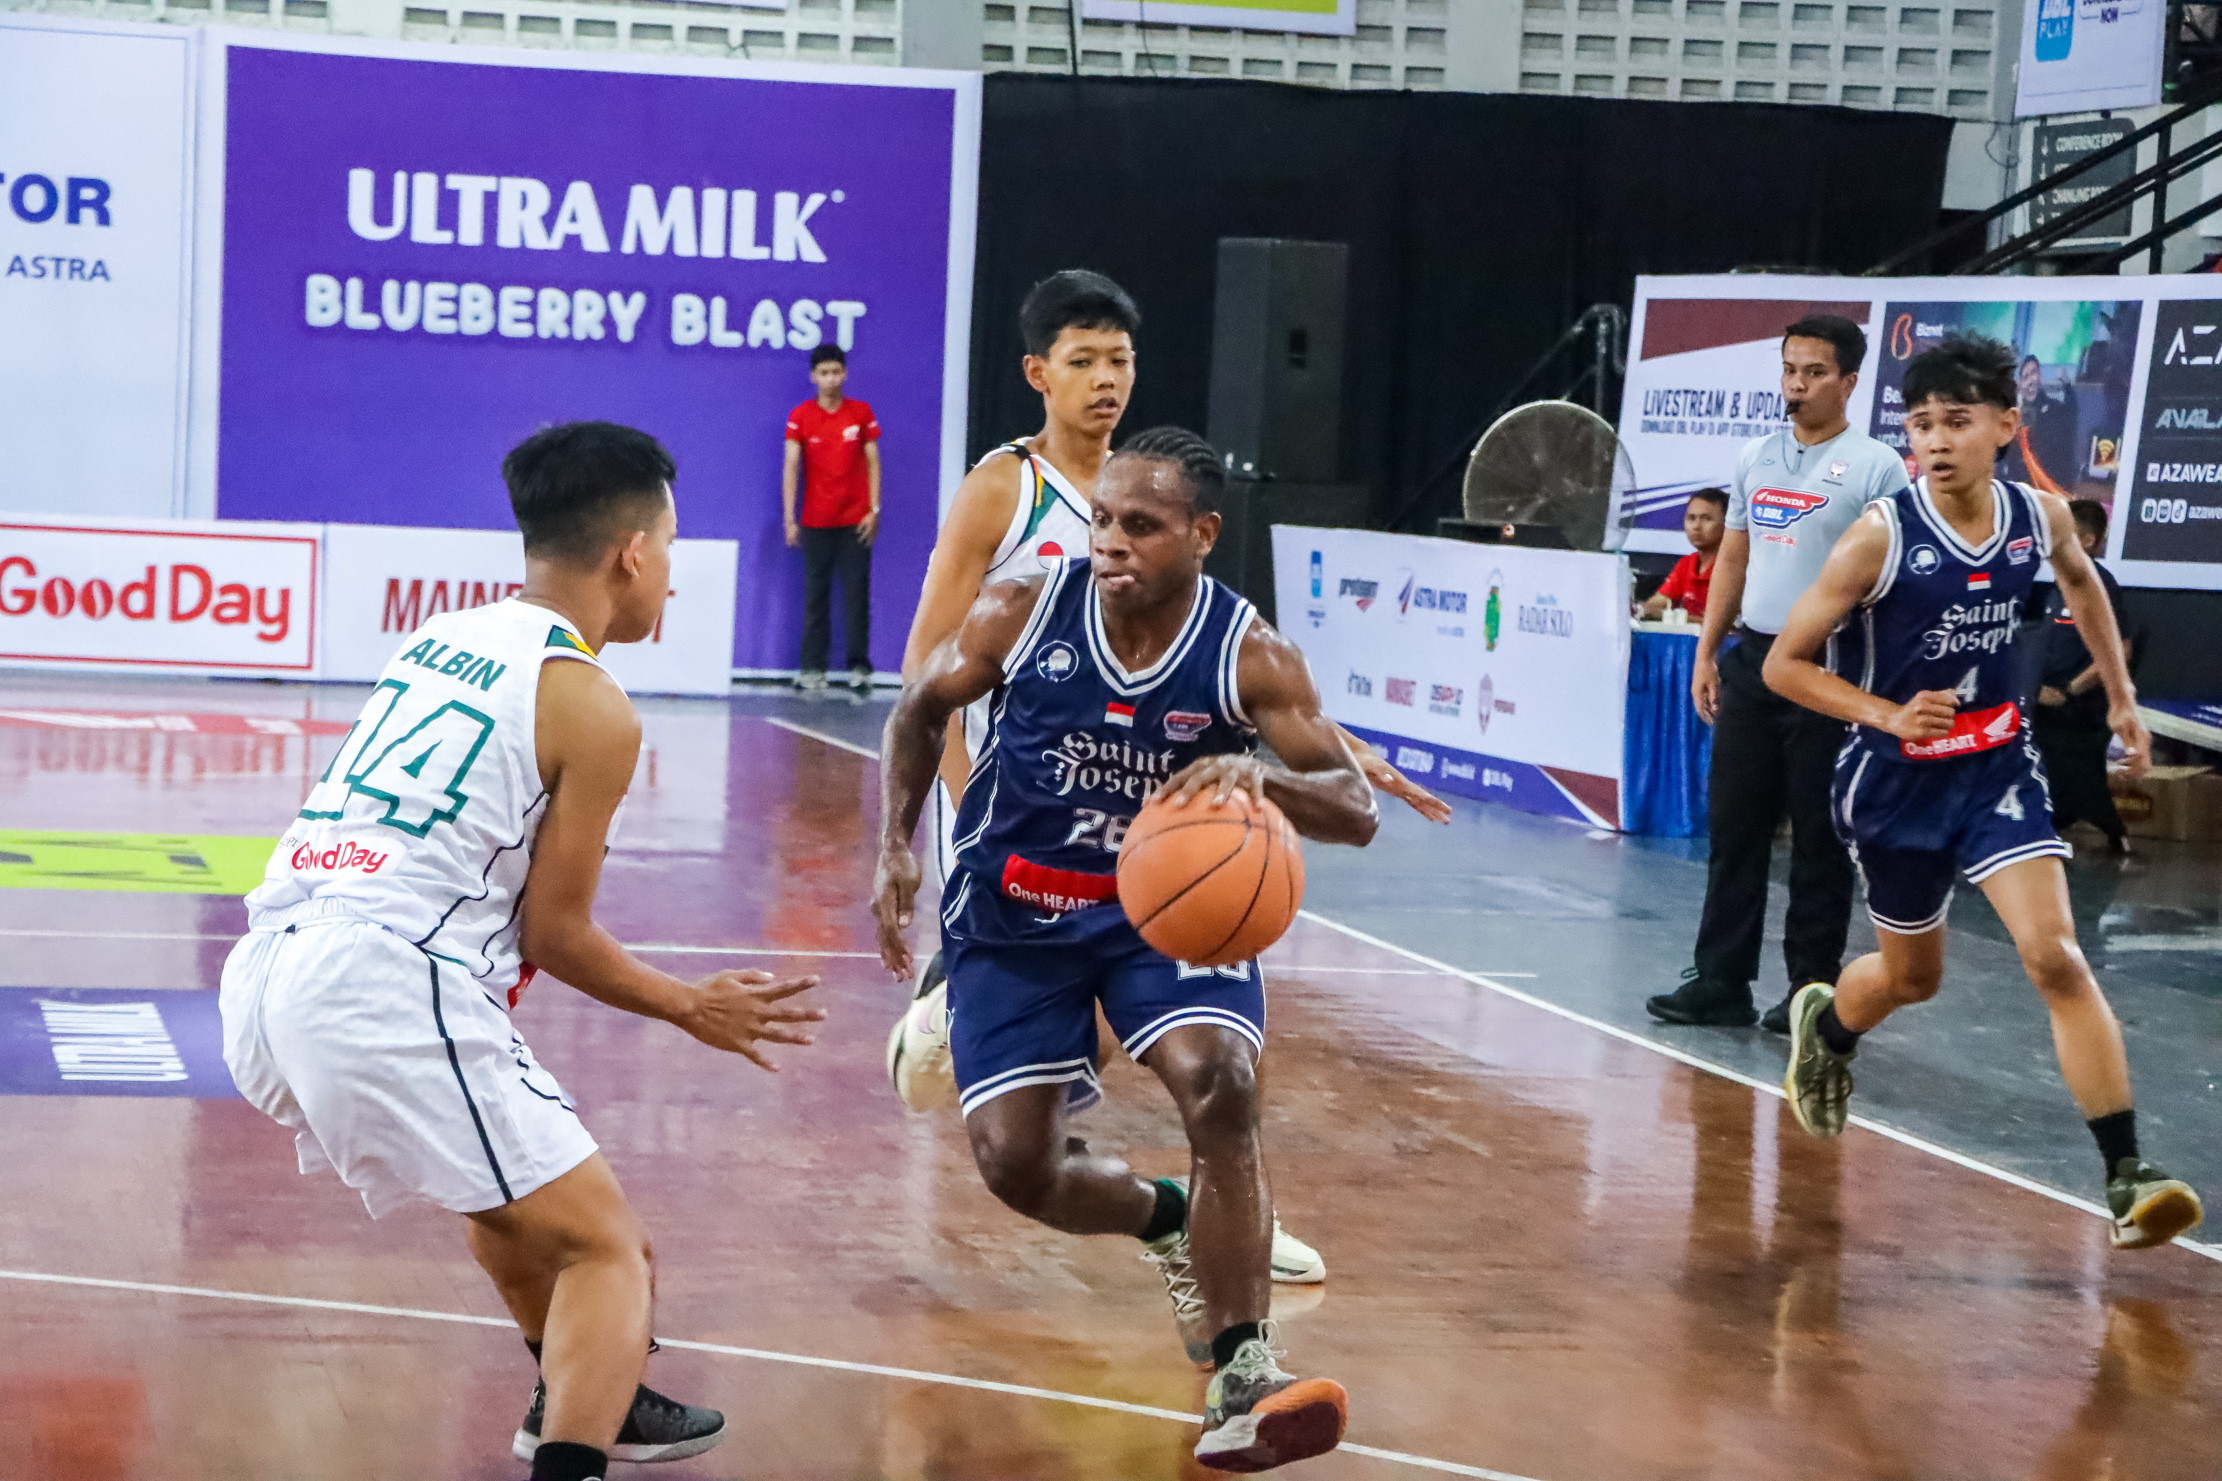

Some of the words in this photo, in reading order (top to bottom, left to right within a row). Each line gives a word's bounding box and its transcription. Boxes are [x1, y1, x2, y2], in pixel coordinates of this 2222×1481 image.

[0, 172, 111, 227] OR
[348, 167, 610, 253] ULTRA
[620, 184, 828, 263] MILK
[6, 255, 110, 282] ASTRA
[305, 273, 647, 343] BLUEBERRY
[670, 292, 867, 352] BLAST
[2164, 326, 2222, 365] AZ
[1729, 392, 1741, 419] &
[1746, 391, 1788, 423] UPDA
[1766, 494, 1806, 508] HONDA
[400, 638, 507, 692] ALBIN
[1956, 665, 1979, 703] 4
[298, 678, 496, 839] 14
[1058, 731, 1175, 774] Saint
[1036, 749, 1163, 807] Josep
[1995, 784, 2025, 821] 4
[1008, 882, 1040, 902] One
